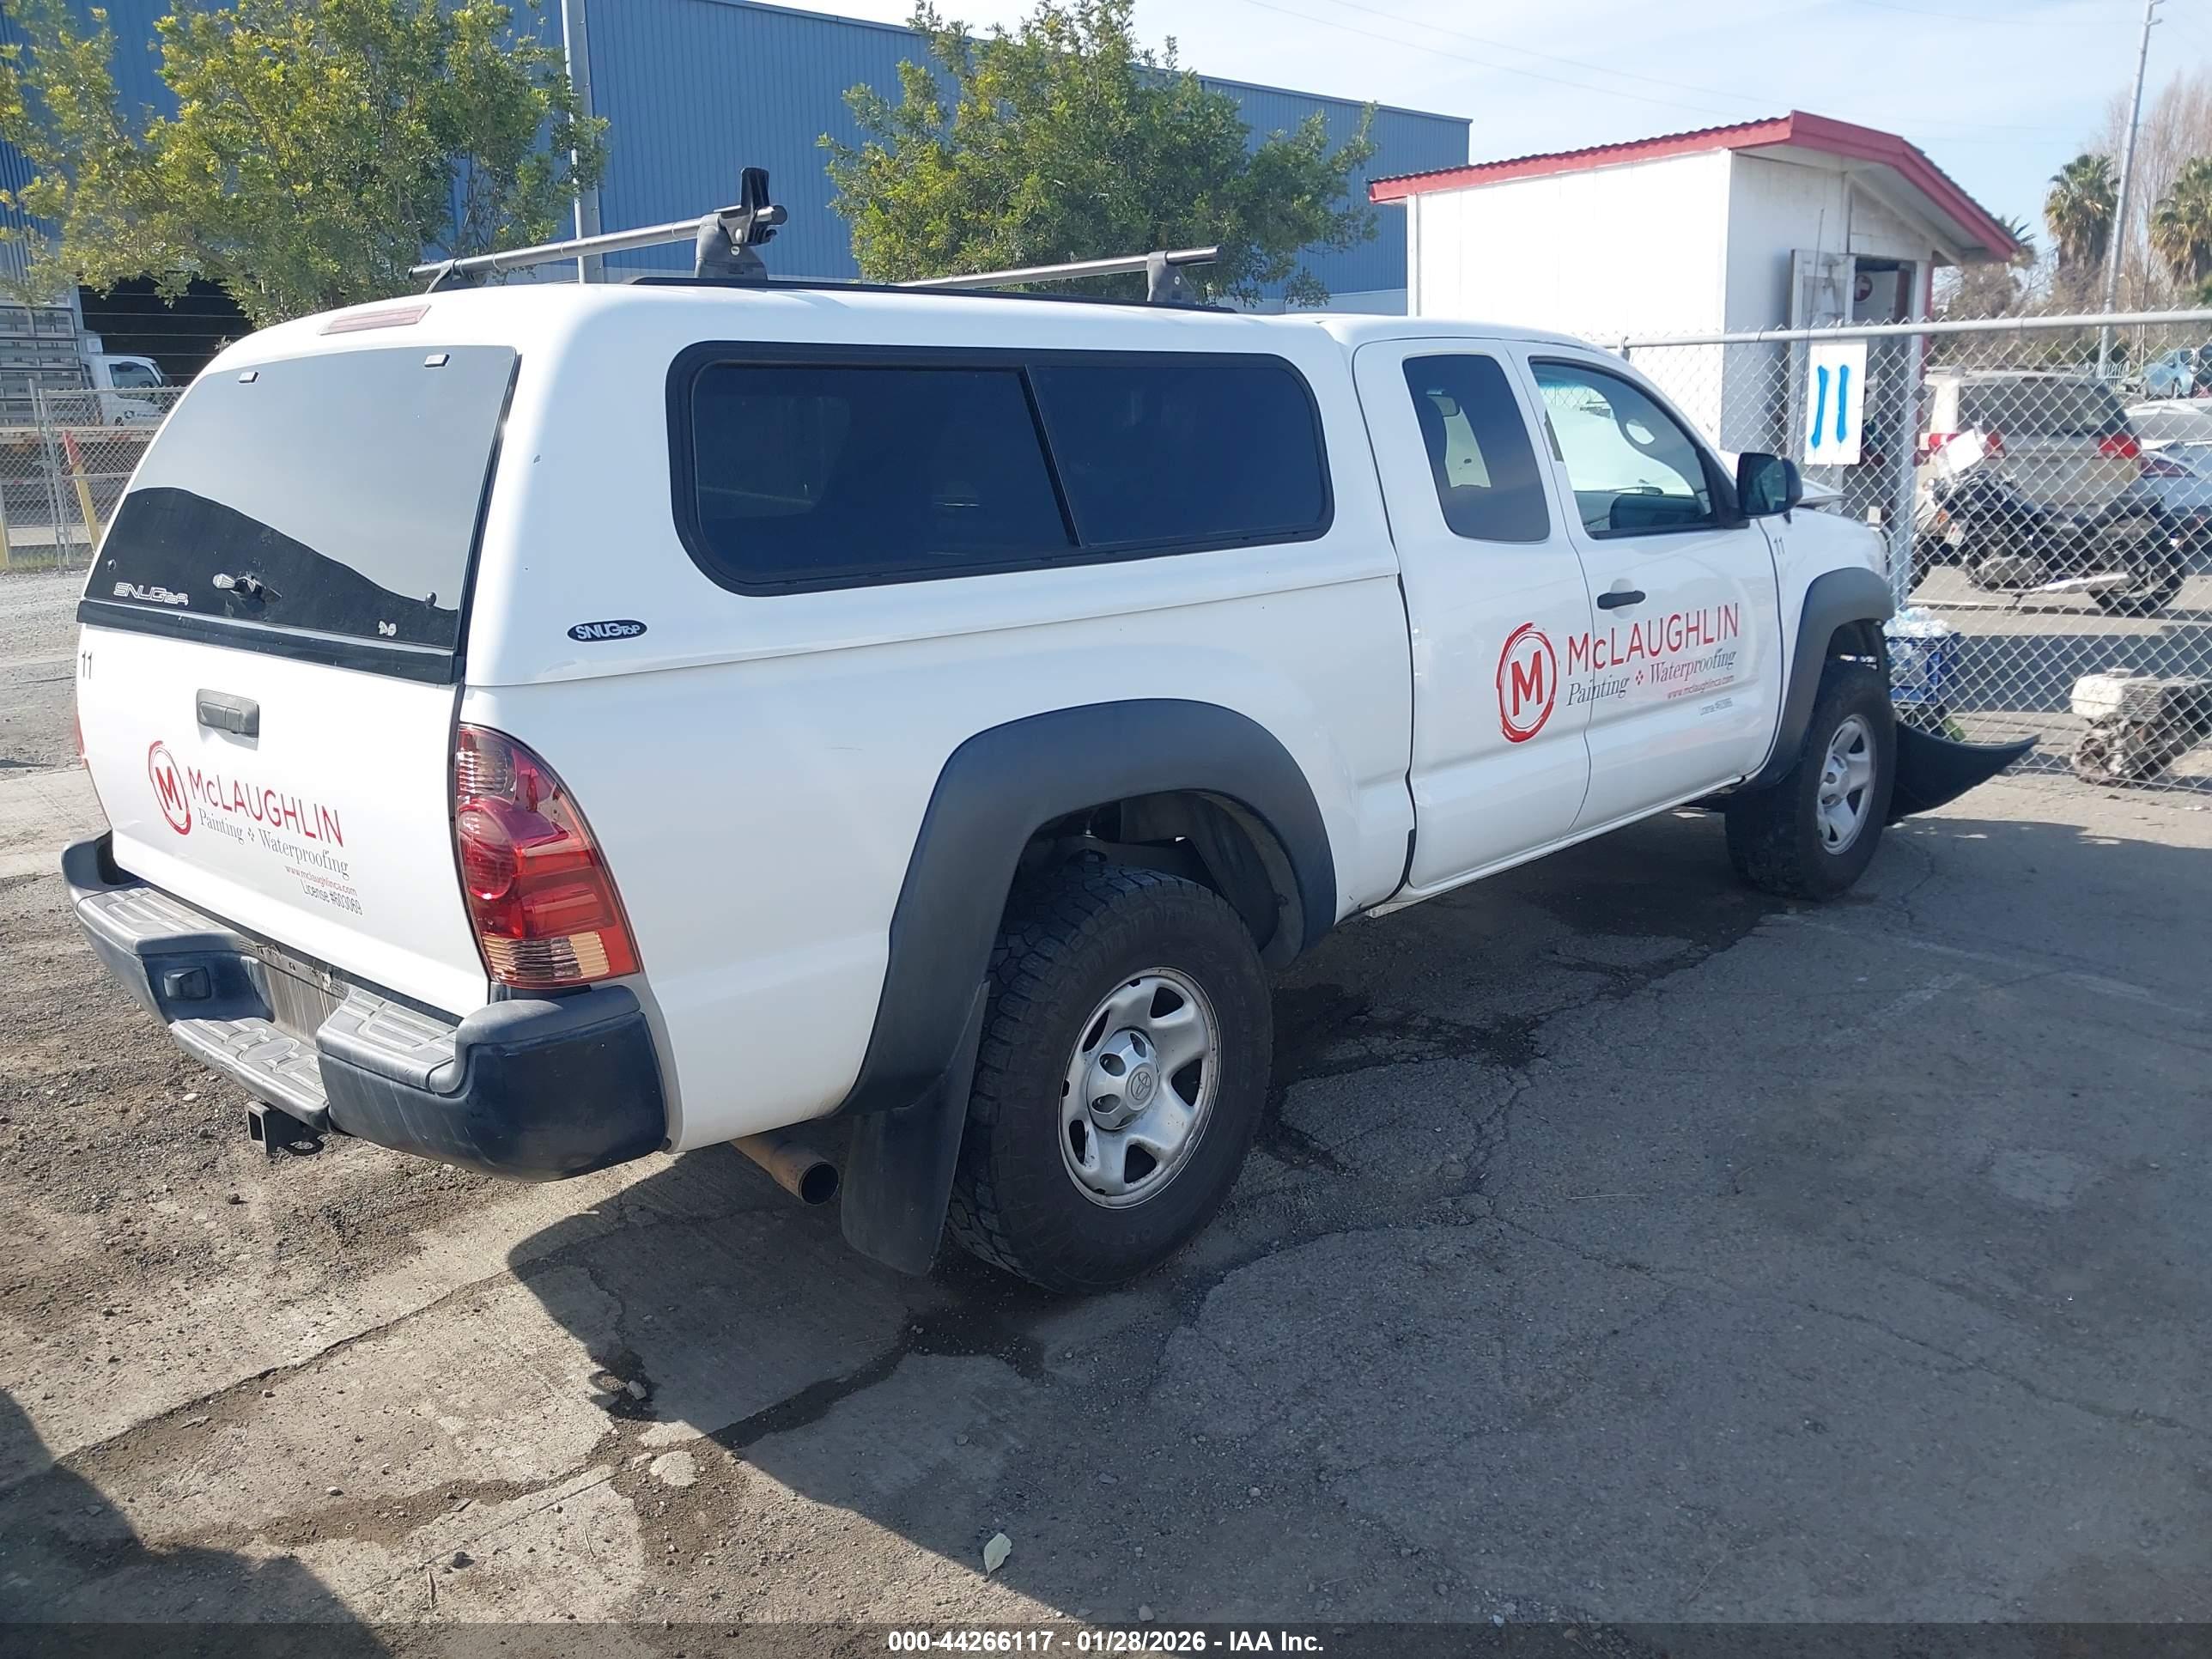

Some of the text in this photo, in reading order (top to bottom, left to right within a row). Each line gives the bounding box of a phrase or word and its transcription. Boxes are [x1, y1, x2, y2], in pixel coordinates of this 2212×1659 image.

[82, 650, 93, 680] 11
[1567, 602, 1739, 676] McLAUGHLIN
[1565, 647, 1737, 707] Painting Waterproofing
[187, 766, 343, 848] McLAUGHLIN
[198, 807, 350, 881] Painting Waterproofing
[300, 878, 330, 903] License
